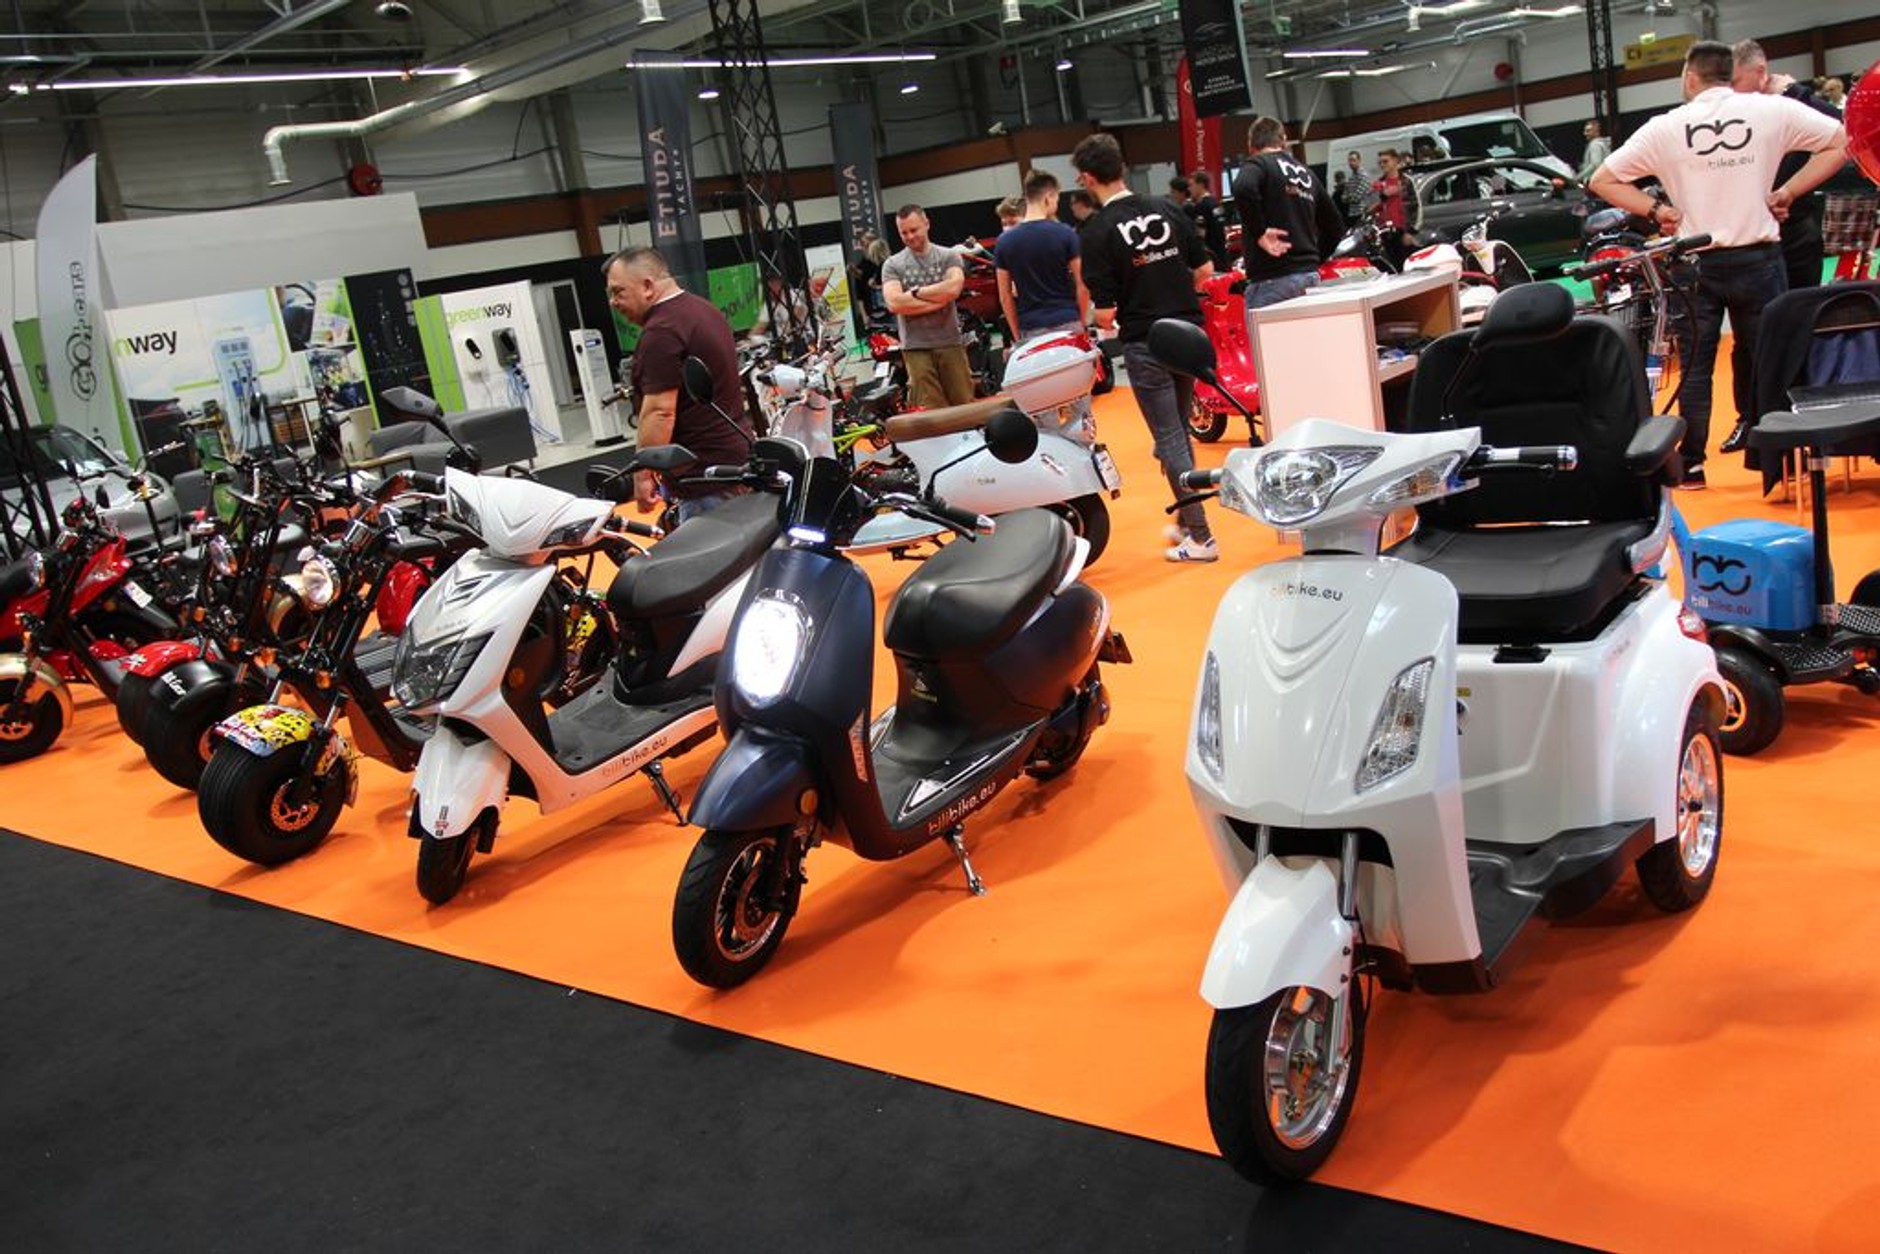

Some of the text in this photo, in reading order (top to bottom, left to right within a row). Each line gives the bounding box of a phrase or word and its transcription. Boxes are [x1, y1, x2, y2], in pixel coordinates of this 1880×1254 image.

[648, 124, 677, 238] ETIUDA
[672, 149, 688, 217] YACHTS
[842, 164, 865, 252] ETIUDA
[445, 301, 512, 328] greenway
[928, 782, 997, 836] bilibike.eu
